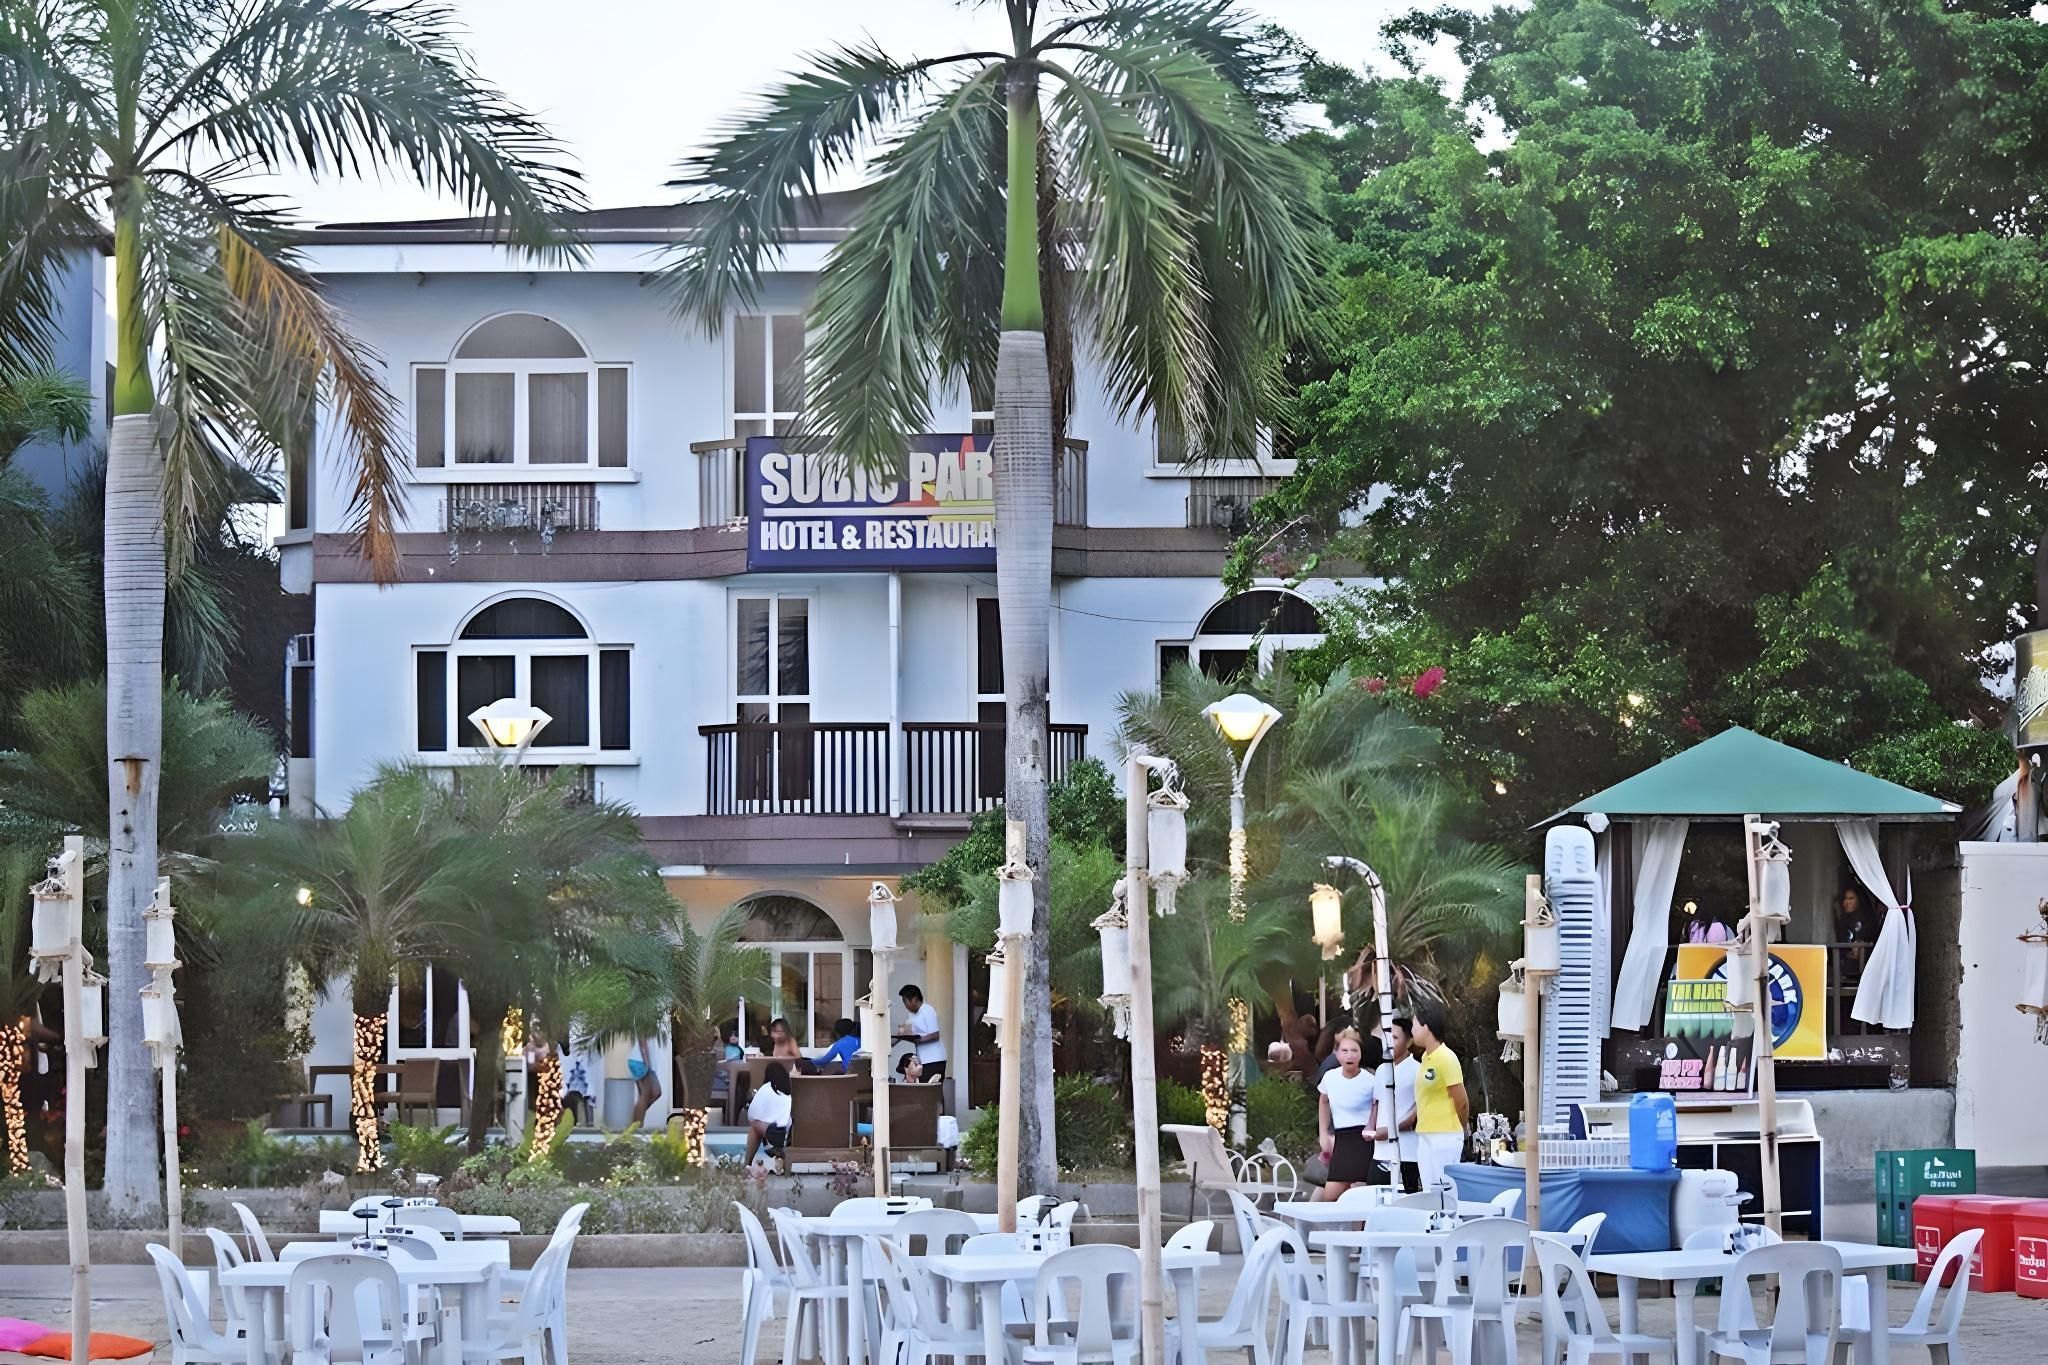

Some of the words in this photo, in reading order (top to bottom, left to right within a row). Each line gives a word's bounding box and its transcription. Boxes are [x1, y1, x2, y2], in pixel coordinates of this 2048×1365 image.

[760, 452, 899, 505] SUBIC
[909, 451, 995, 502] PAR
[760, 520, 837, 551] HOTEL
[842, 524, 862, 550] &
[866, 519, 996, 550] RESTAURA
